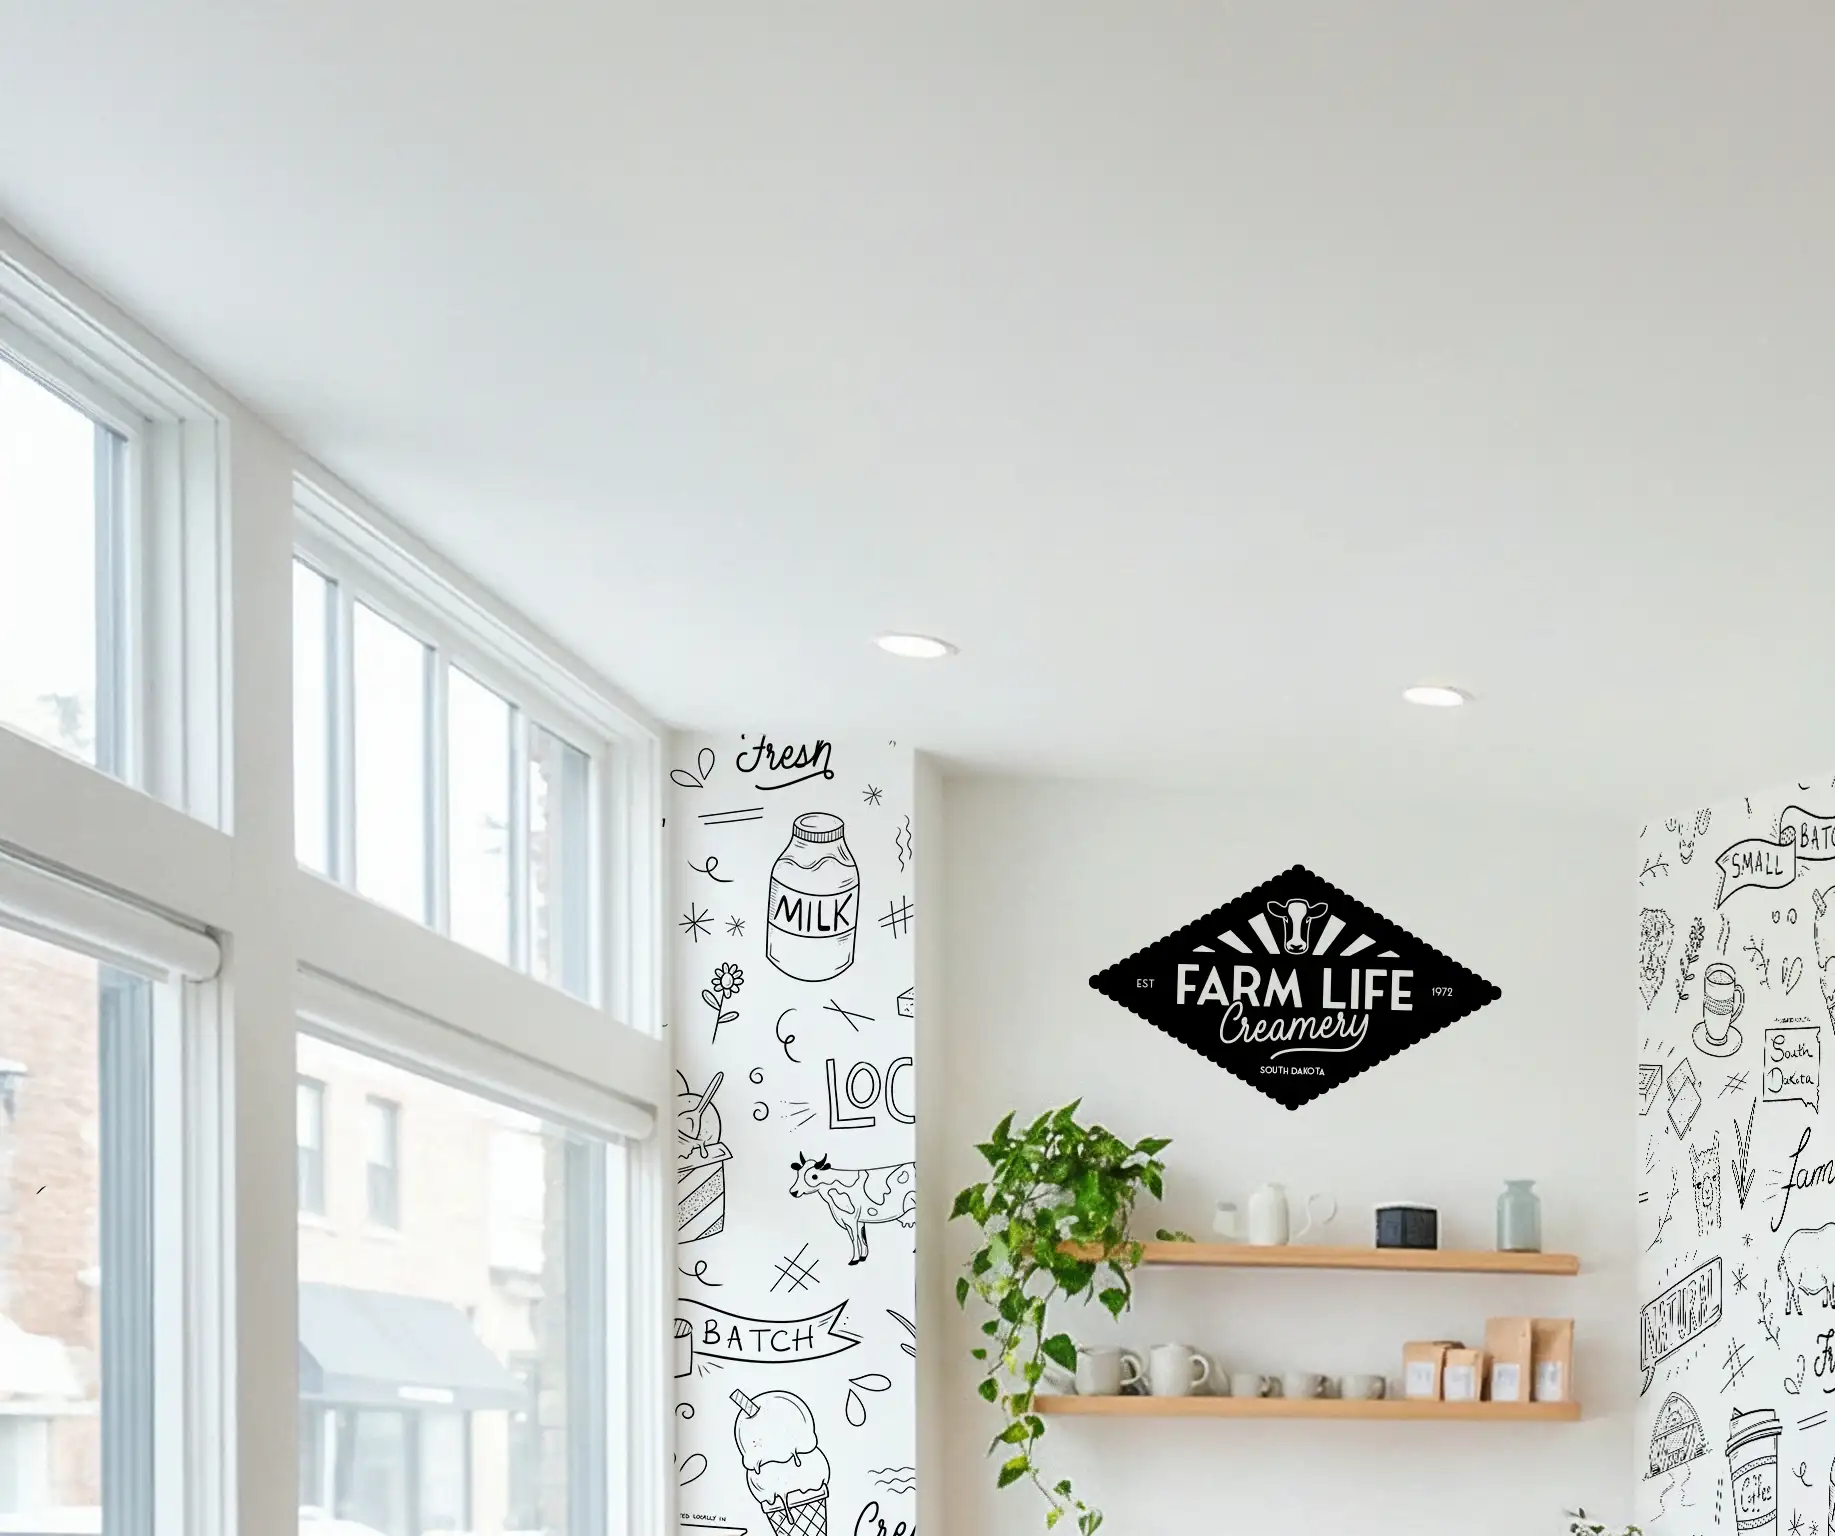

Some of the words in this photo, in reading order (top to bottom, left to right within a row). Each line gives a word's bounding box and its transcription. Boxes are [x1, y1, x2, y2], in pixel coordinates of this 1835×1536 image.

[1731, 852, 1784, 877] SMALL
[773, 892, 853, 933] MILK
[1136, 978, 1155, 988] EST
[1176, 963, 1302, 1008] FARM
[1323, 967, 1414, 1011] LIFE
[1431, 986, 1453, 997] 1972
[1219, 1000, 1370, 1060] Creamery
[1770, 1034, 1813, 1062] South
[1259, 1065, 1289, 1075] SOUTH
[1291, 1066, 1326, 1076] DAKOTA
[702, 1319, 815, 1351] BATCH
